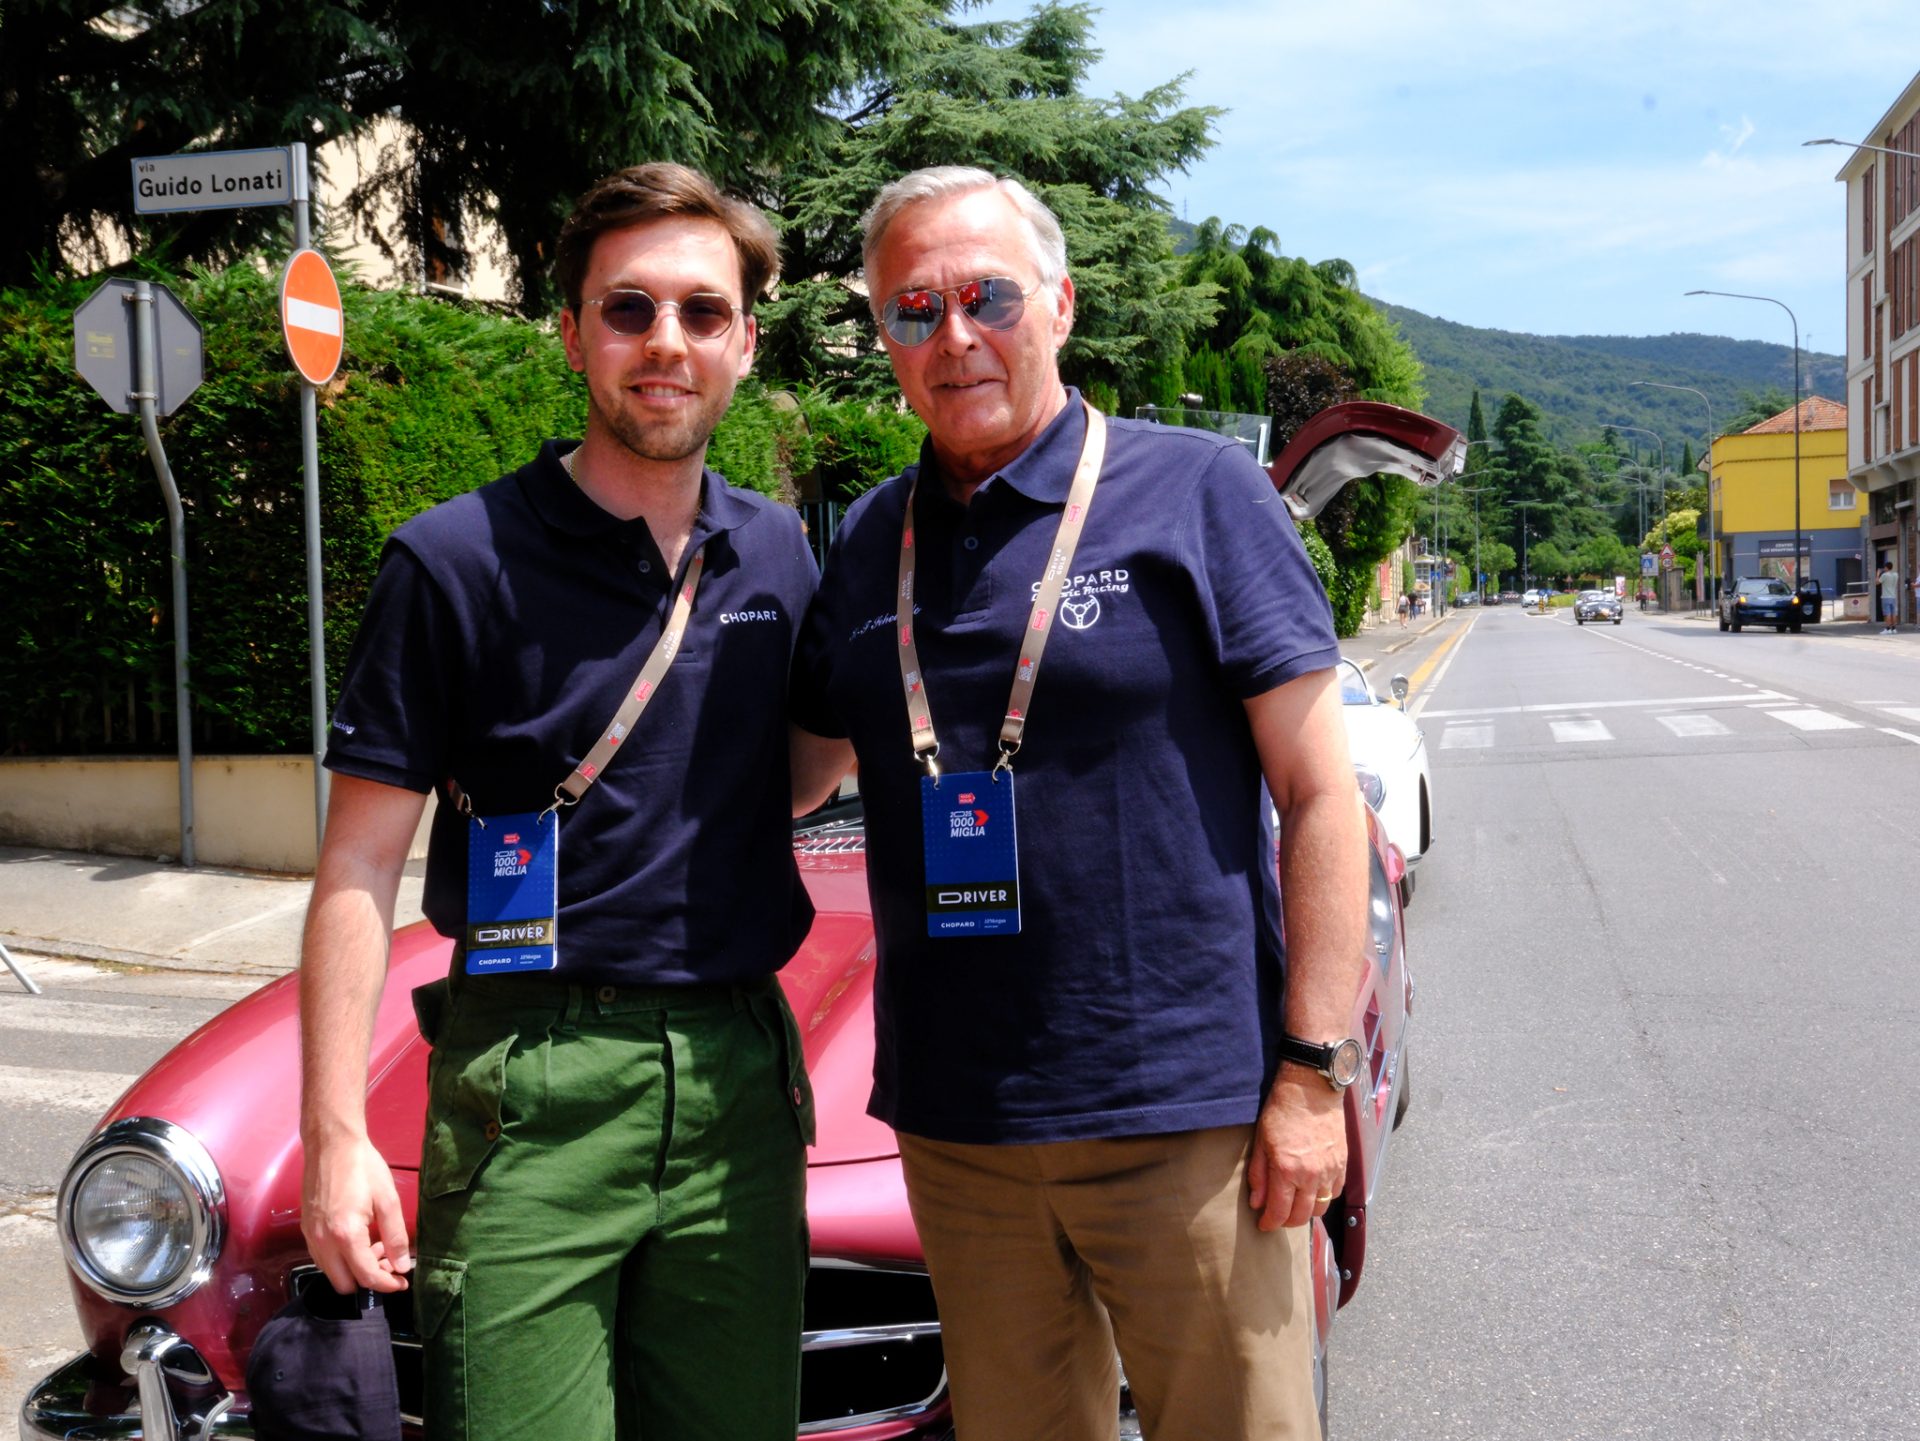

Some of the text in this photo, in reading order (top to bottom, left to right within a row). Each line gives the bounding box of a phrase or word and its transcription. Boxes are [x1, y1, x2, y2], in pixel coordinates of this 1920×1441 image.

[138, 162, 155, 173] via
[138, 169, 283, 198] Guido Lonati
[1031, 569, 1129, 592] COPARD
[1082, 582, 1129, 598] Racing
[949, 817, 974, 827] 1000
[950, 826, 985, 838] MIGLIA
[494, 857, 517, 867] 1000
[494, 865, 527, 877] MIGLIA
[938, 890, 1007, 904] DRIVER
[940, 921, 975, 929] CHOPARD
[478, 926, 544, 942] DRIVER
[478, 957, 512, 965] CHOPARD
